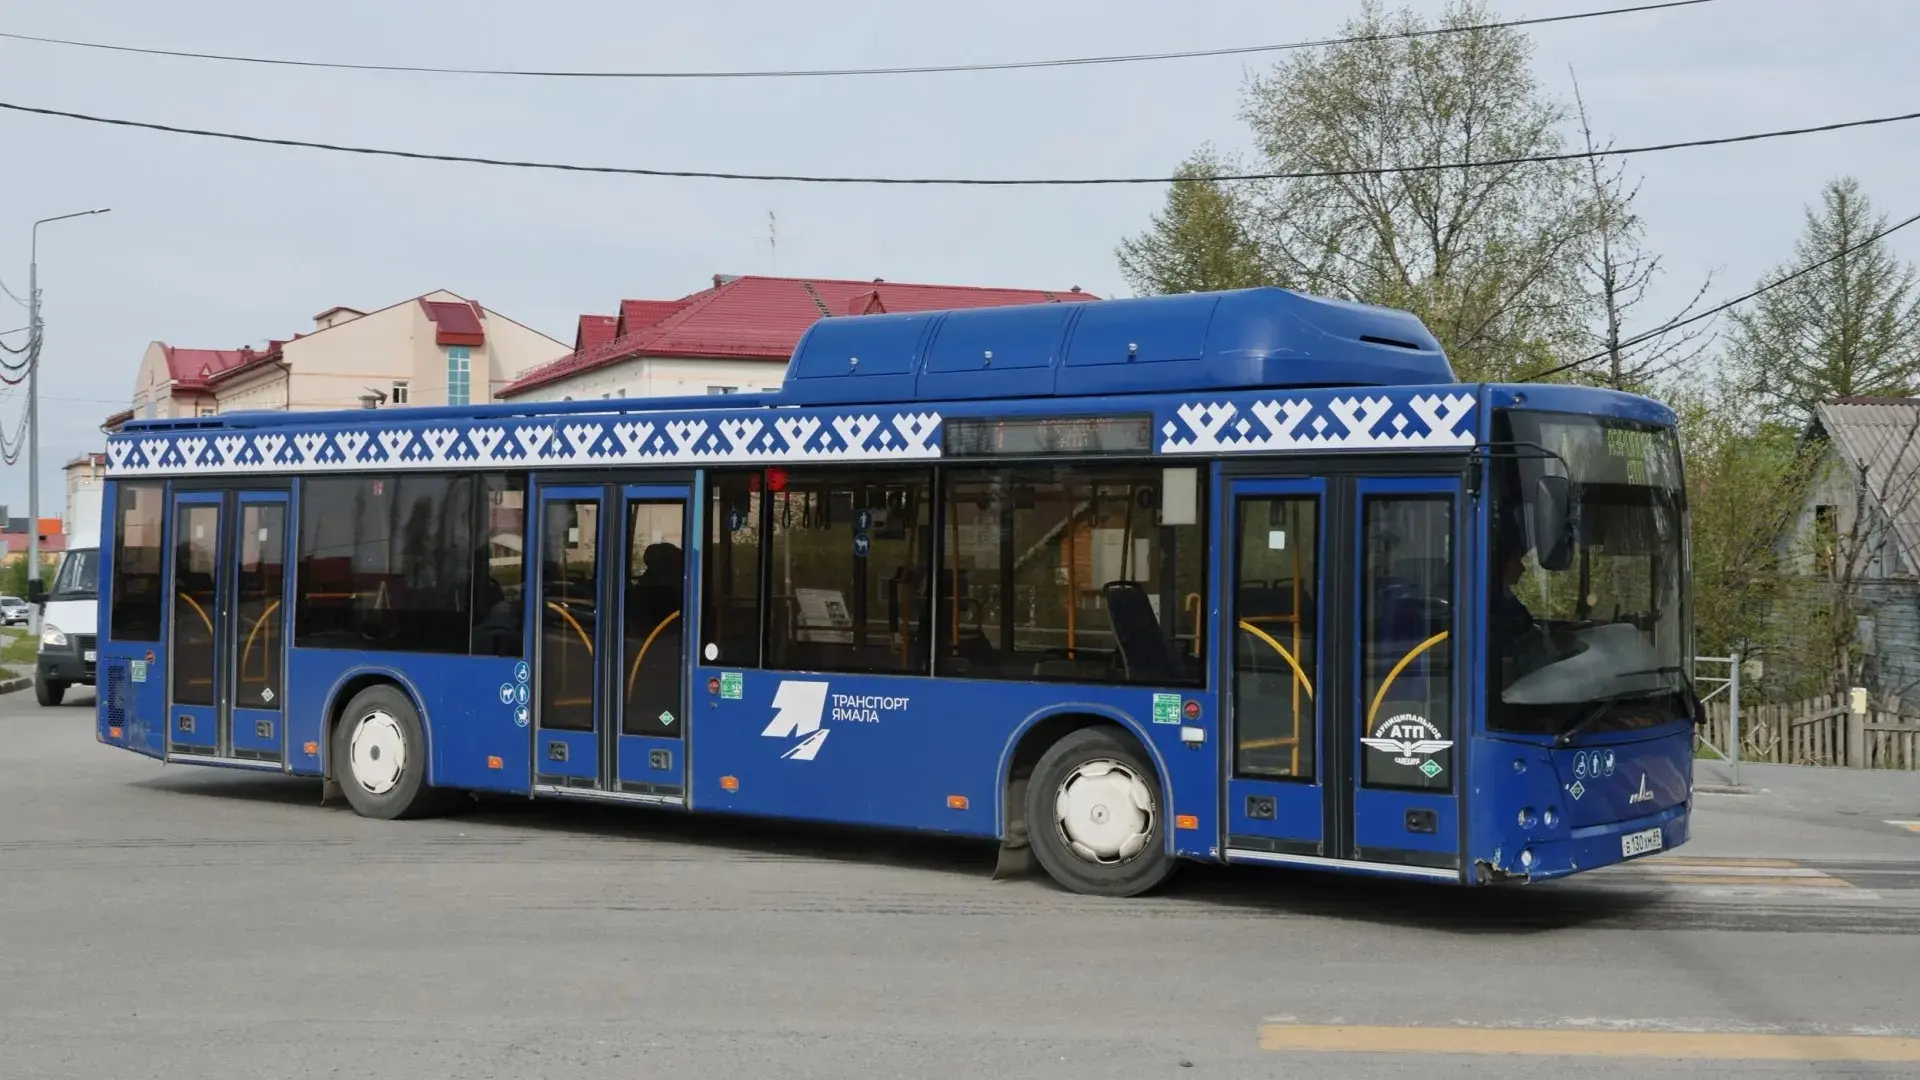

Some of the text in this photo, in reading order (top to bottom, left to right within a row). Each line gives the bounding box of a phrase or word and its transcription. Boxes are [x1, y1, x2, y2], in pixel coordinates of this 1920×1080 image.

[832, 694, 910, 711] ТРАНСПОРТ
[832, 707, 880, 723] ЯМАЛА
[1375, 713, 1442, 740] МУНИЦИПАЛЬНОЕ
[1390, 724, 1425, 739] АТП
